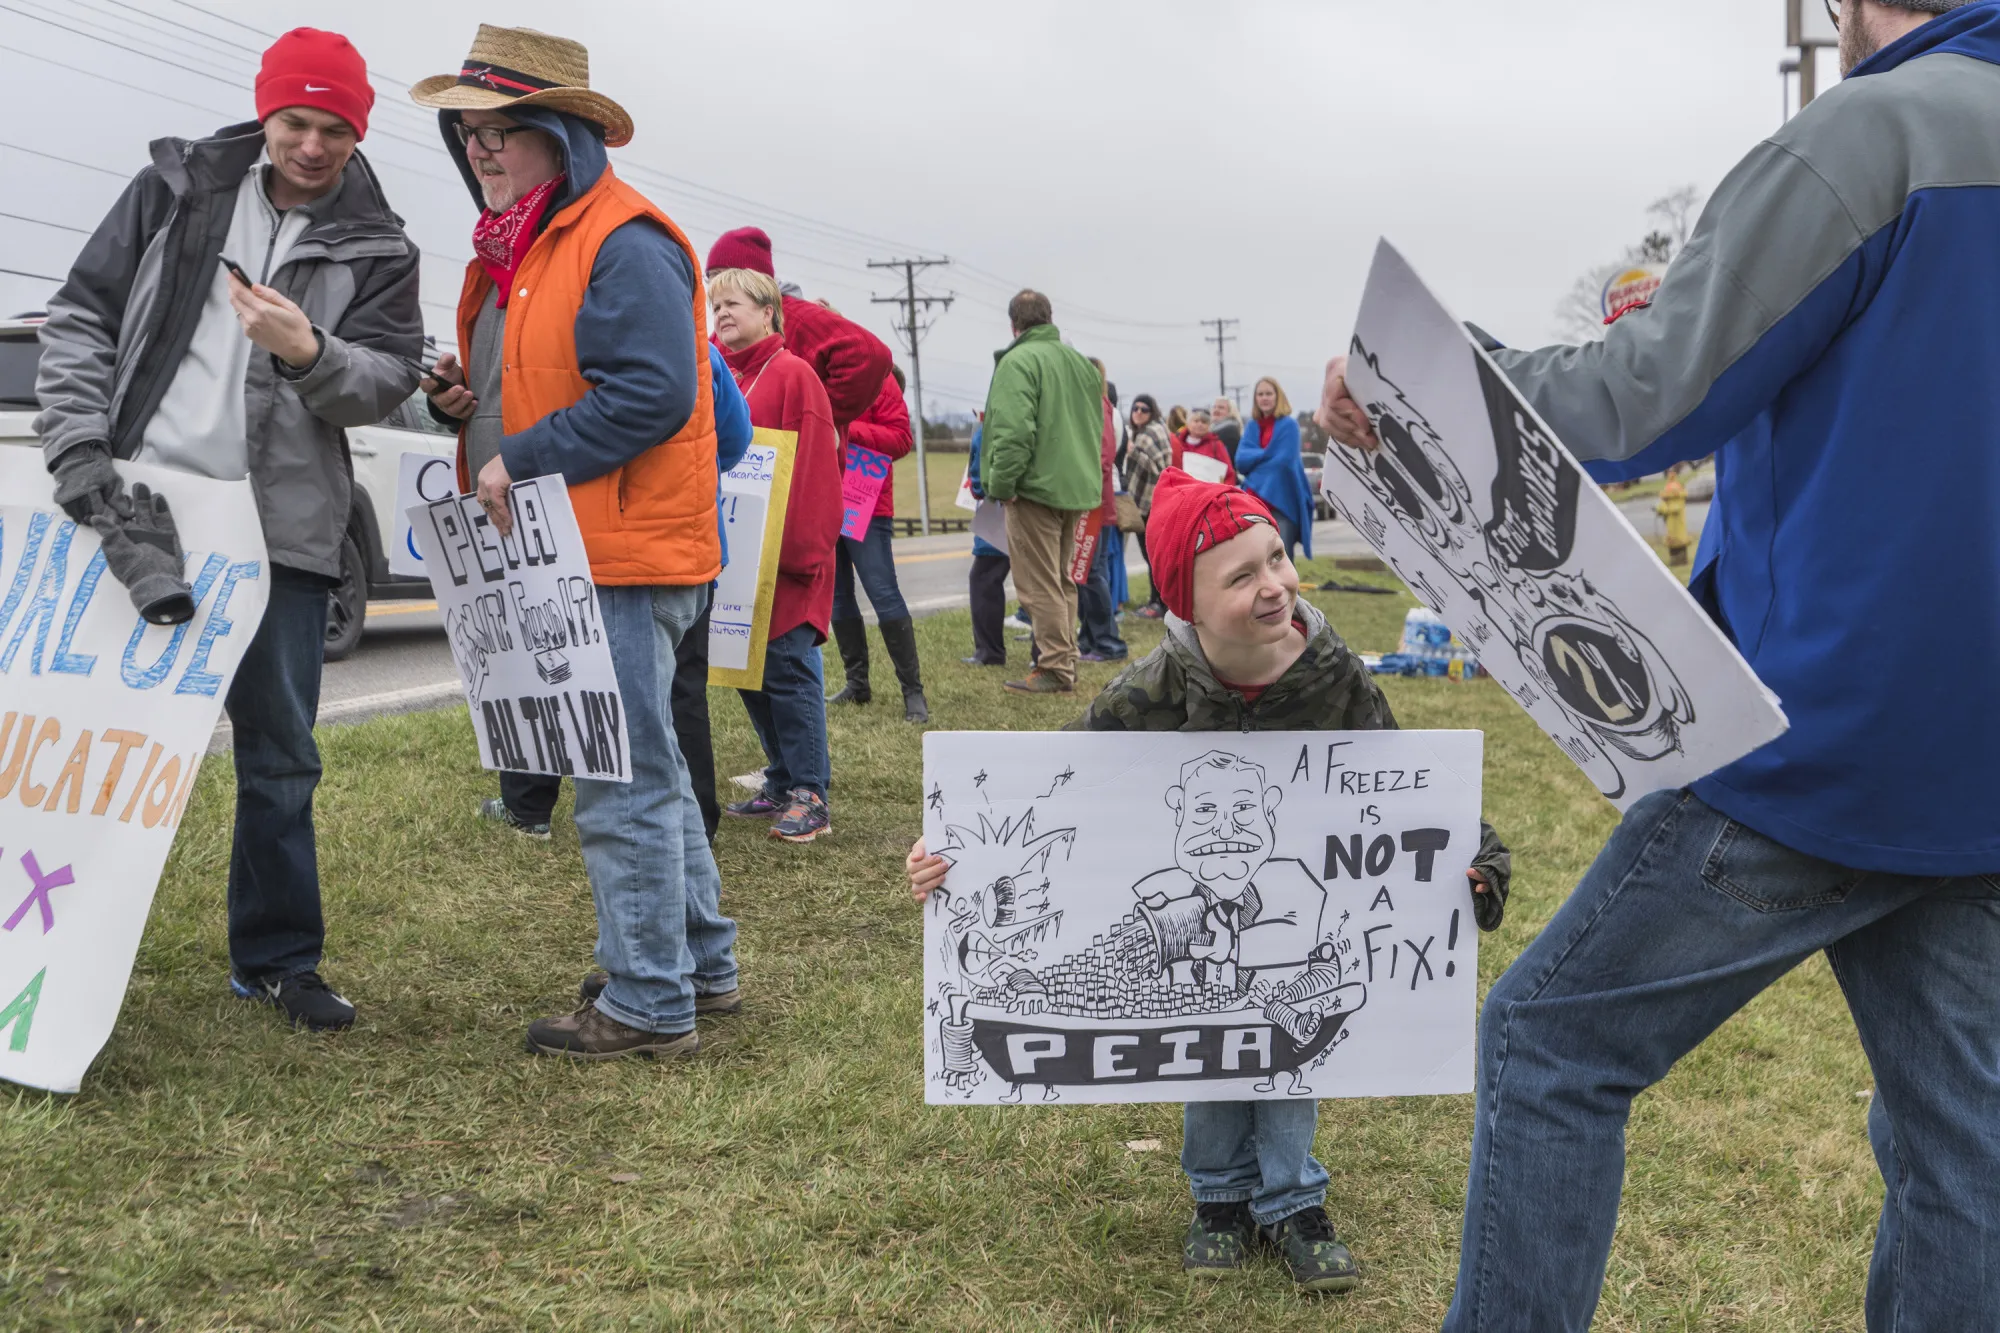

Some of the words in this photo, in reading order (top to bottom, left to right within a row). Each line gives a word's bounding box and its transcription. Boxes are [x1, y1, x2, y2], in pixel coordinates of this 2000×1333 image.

[1081, 534, 1095, 558] KIDS
[1326, 489, 1386, 555] Please
[1491, 498, 1531, 564] STATE
[1073, 559, 1088, 581] OUR
[557, 575, 600, 647] IT!
[1502, 679, 1540, 709] Some
[1550, 633, 1645, 722] 2%
[482, 698, 530, 770] ALL
[518, 695, 575, 776] THE
[563, 690, 623, 778] WAY
[1290, 744, 1309, 783] A
[1324, 741, 1431, 796] FREEZE
[1359, 804, 1382, 826] IS
[1323, 827, 1451, 882] NOT
[1369, 884, 1395, 911] A
[1362, 908, 1460, 991] FIX!
[1005, 1026, 1273, 1080] PEIA
